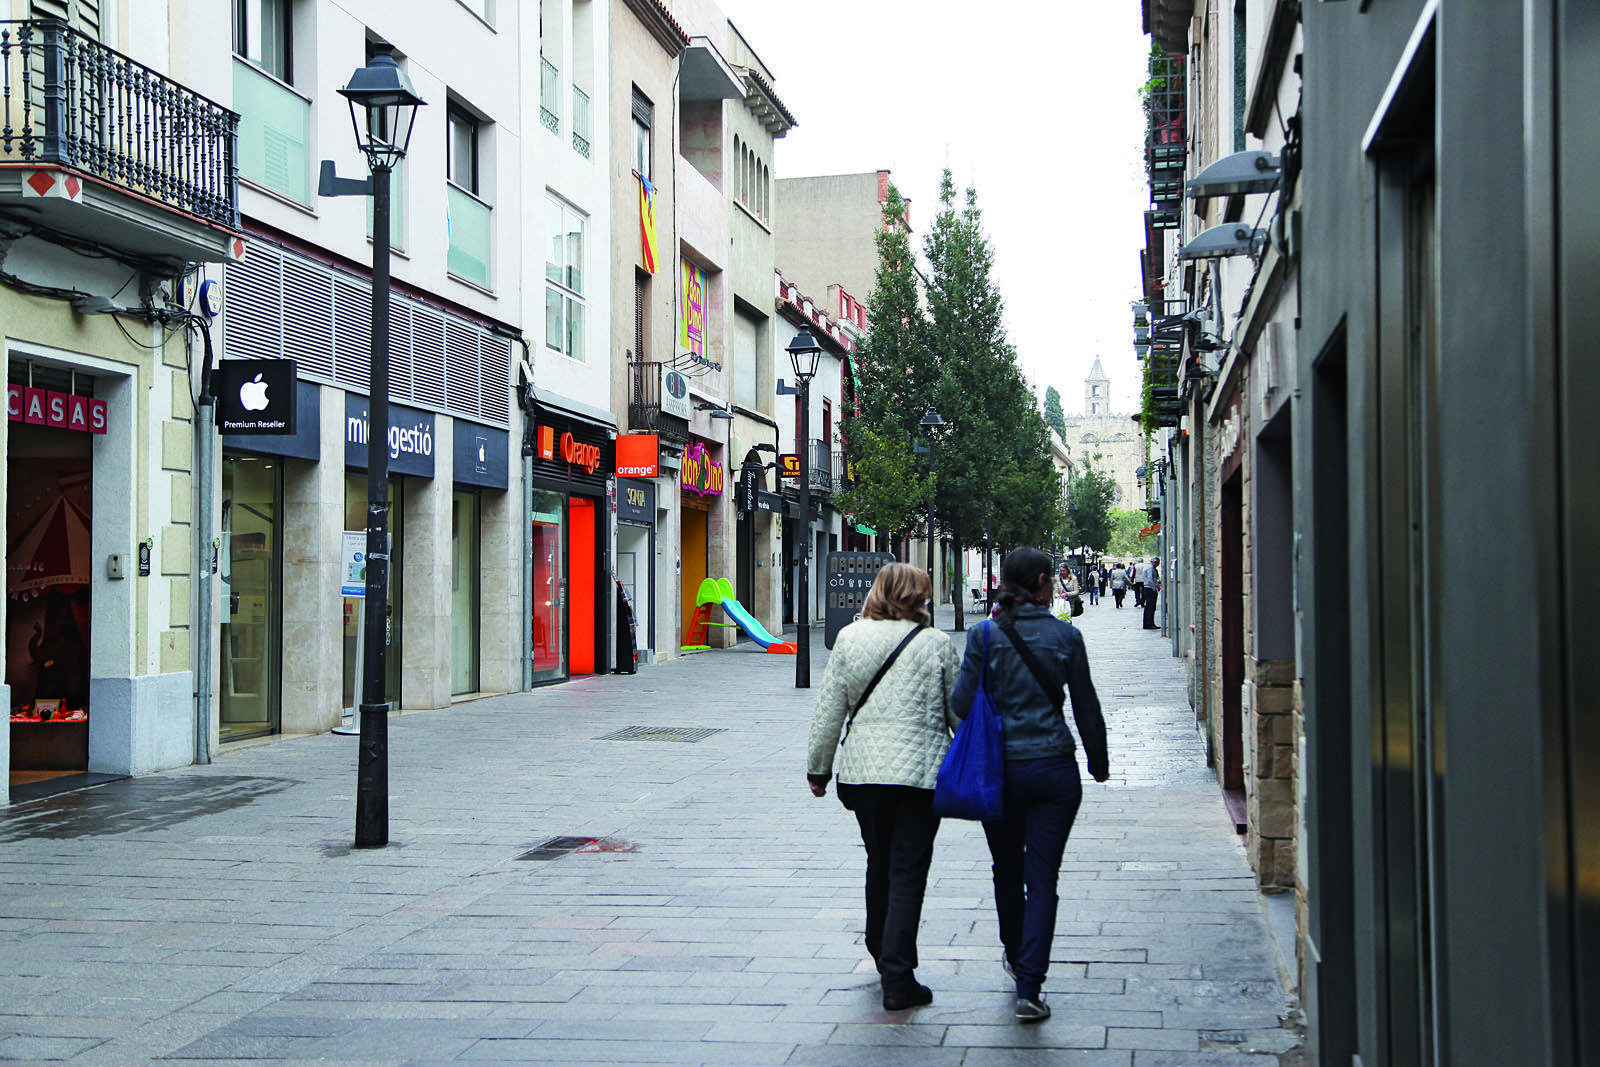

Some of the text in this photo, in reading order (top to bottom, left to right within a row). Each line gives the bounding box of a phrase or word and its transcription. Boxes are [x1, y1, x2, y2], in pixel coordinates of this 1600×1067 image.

[8, 389, 105, 428] CASAS
[224, 420, 286, 429] Premium Reseller
[348, 410, 432, 459] migestió
[561, 431, 601, 475] Orange
